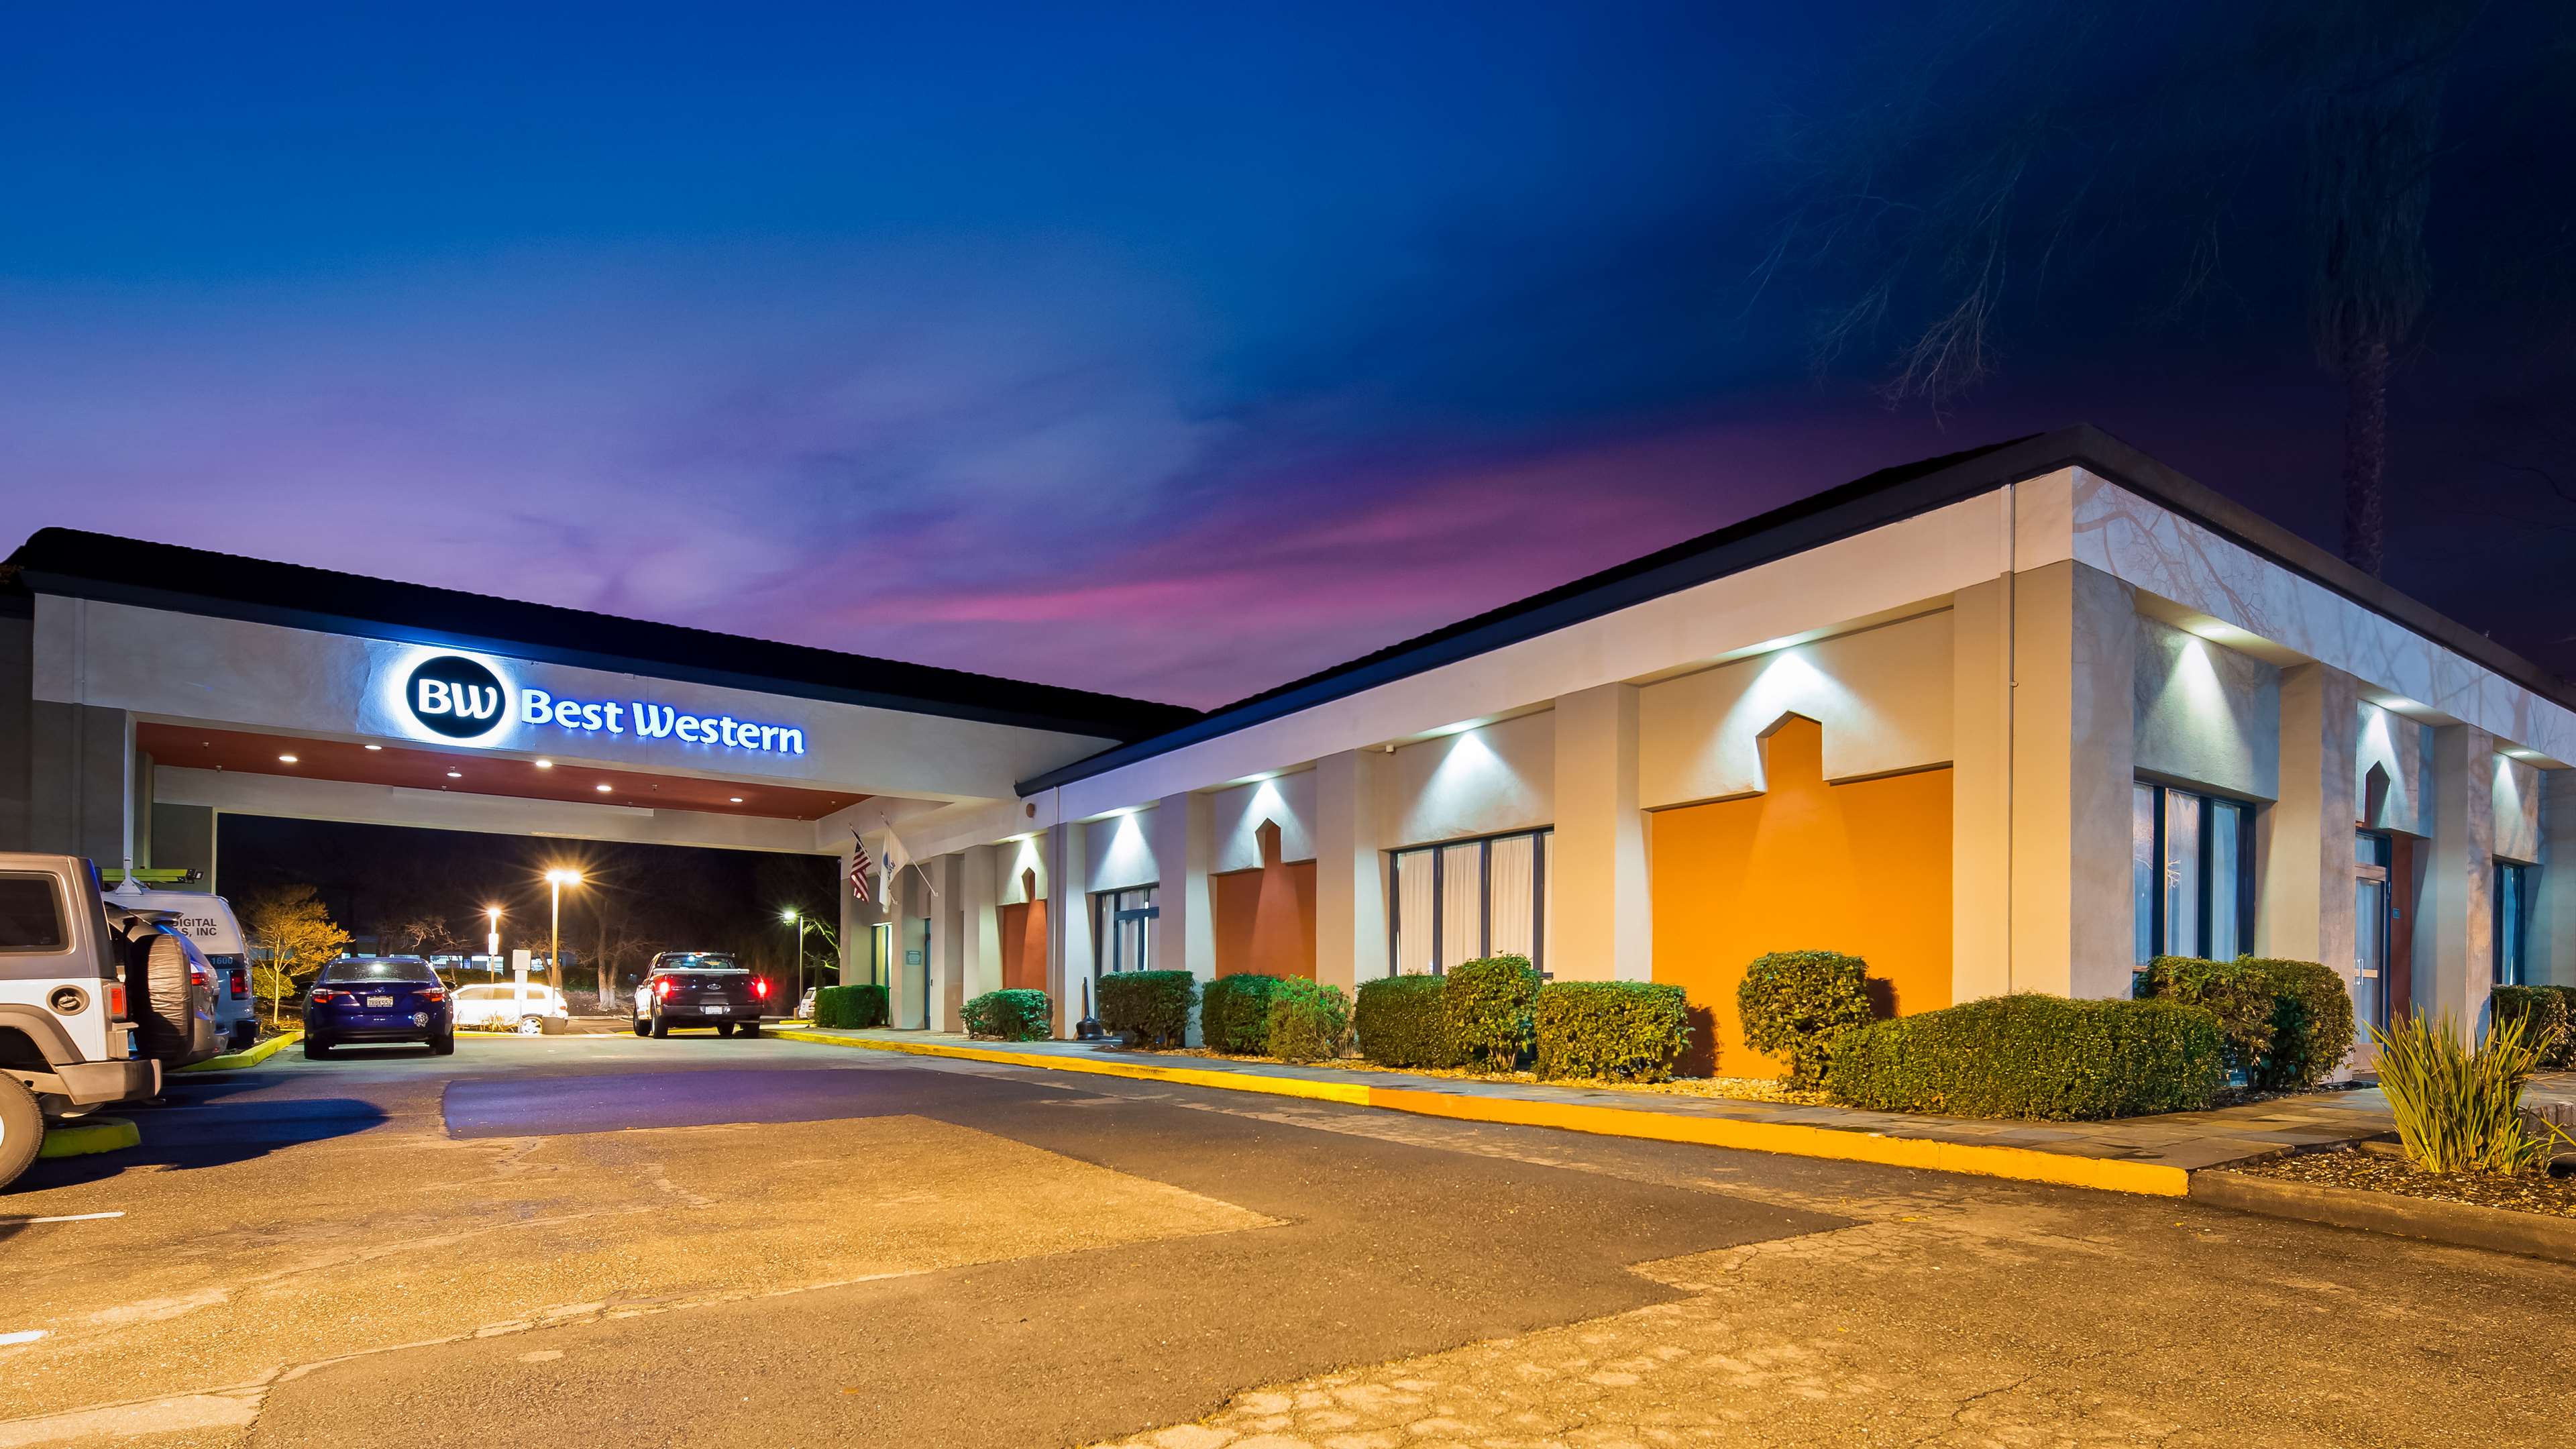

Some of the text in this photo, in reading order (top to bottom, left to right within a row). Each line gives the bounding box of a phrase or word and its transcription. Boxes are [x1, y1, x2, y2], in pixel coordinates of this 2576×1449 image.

[419, 678, 498, 720] BW
[521, 688, 805, 754] Best Western
[172, 918, 217, 926] DIGITAL
[197, 928, 217, 936] INC
